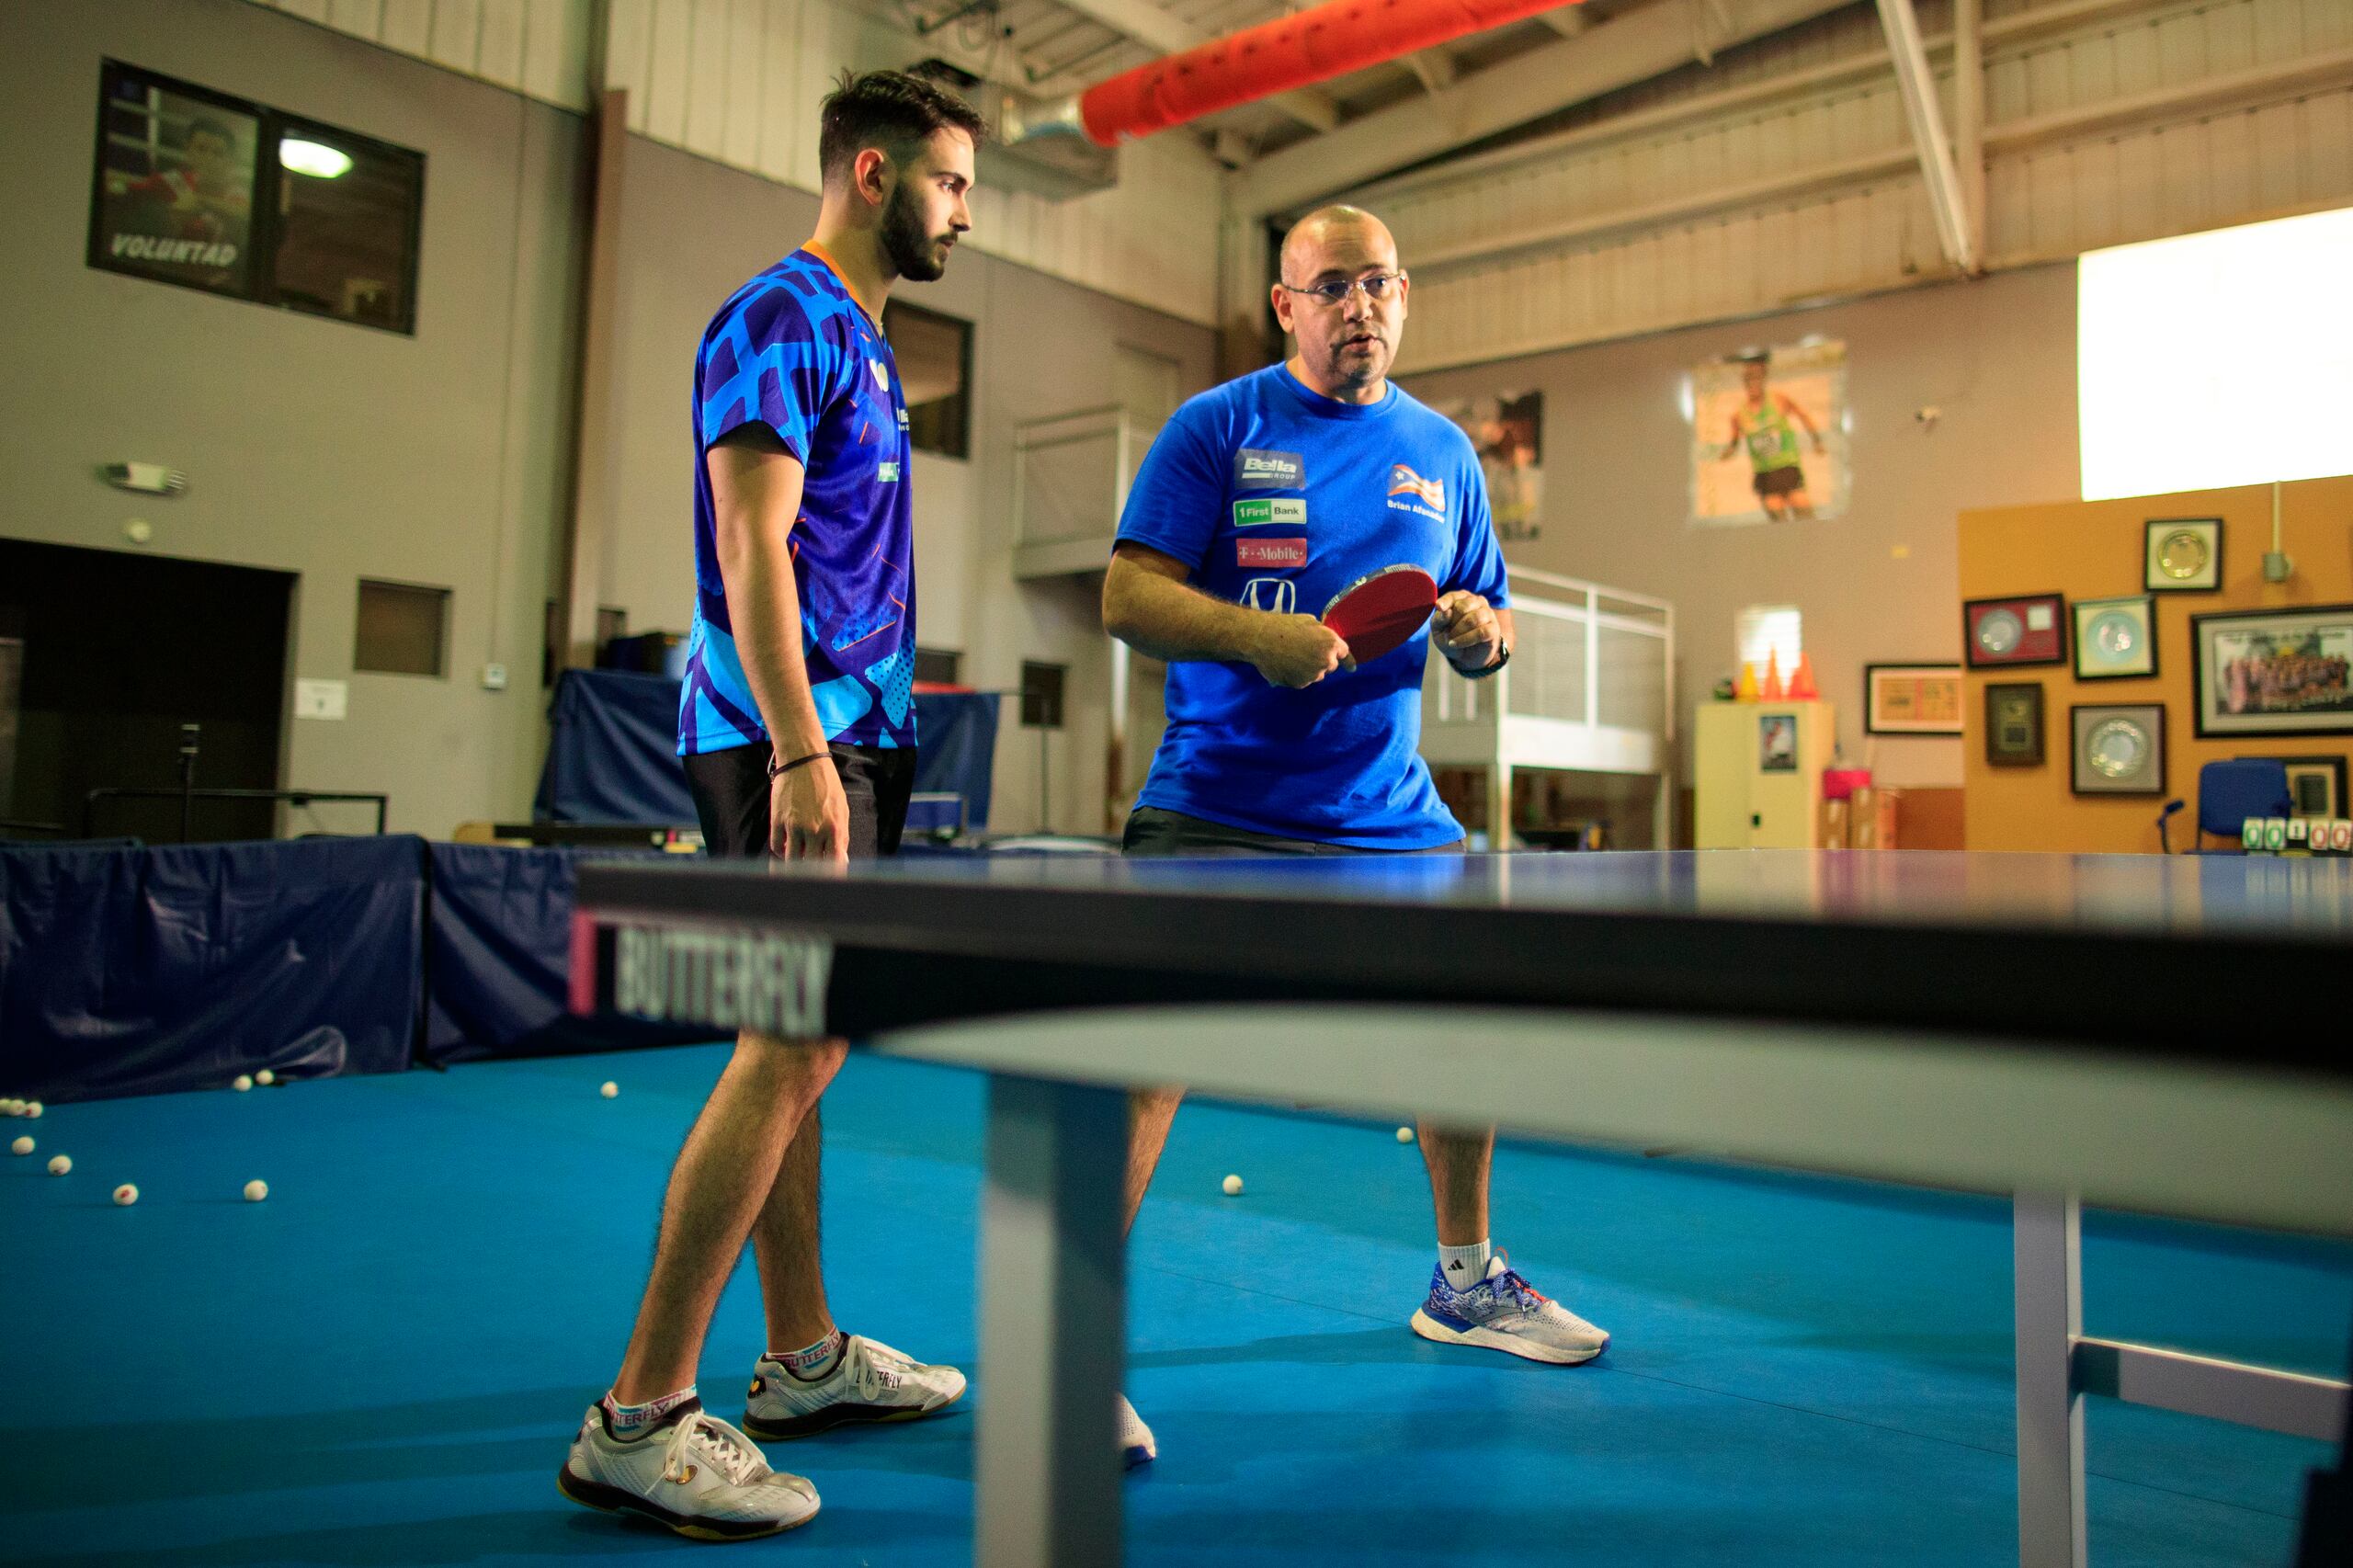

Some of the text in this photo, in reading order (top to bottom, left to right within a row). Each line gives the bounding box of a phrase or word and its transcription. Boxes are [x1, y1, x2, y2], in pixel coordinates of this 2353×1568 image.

[111, 233, 238, 267] VOLUNTAD
[1245, 458, 1297, 472] Bella
[1274, 506, 1299, 516] Bank
[1387, 499, 1411, 511] Brian
[614, 925, 832, 1039] BUTTERFLY
